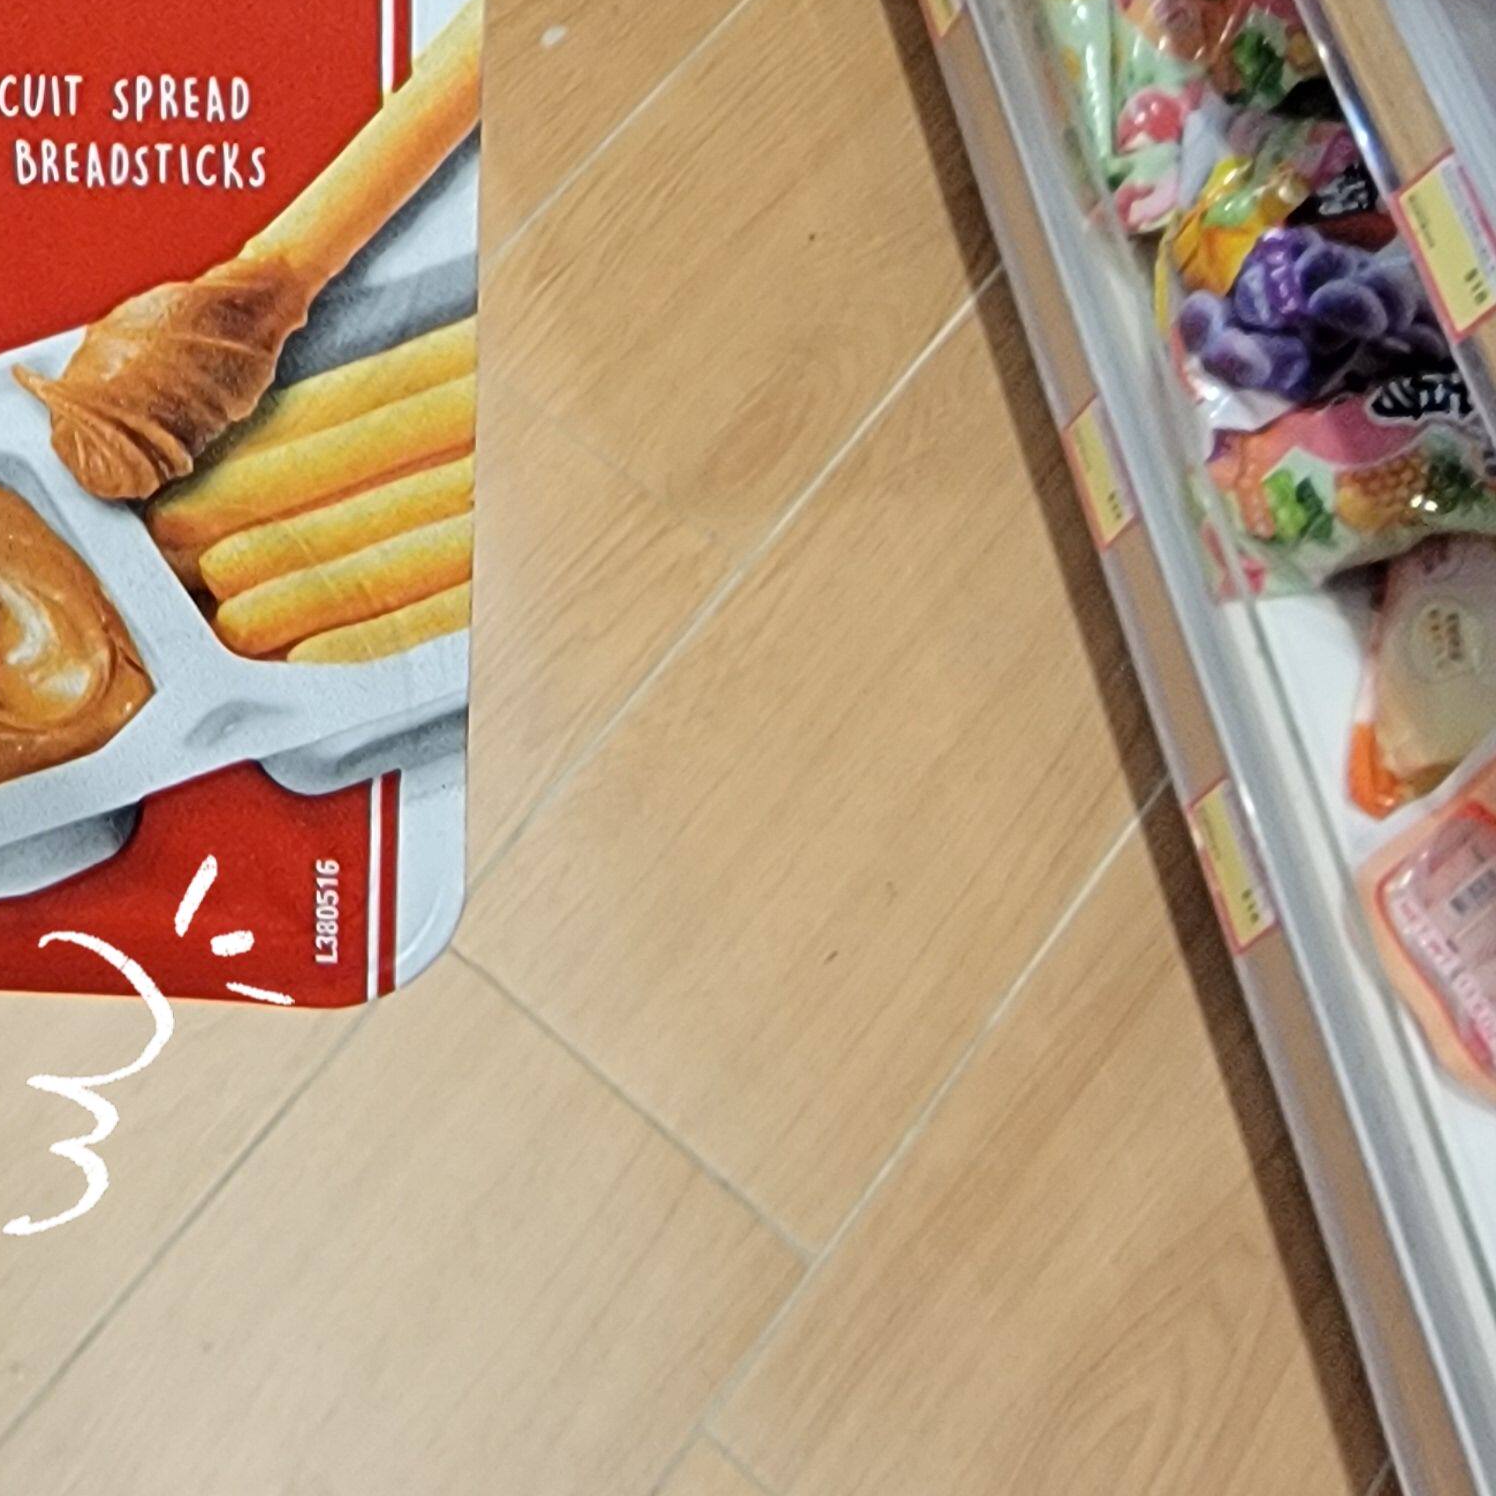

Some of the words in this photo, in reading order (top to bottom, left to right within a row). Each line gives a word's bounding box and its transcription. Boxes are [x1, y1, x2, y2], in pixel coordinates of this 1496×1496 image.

[111, 75, 250, 123] SPREAD
[14, 141, 267, 189] BREADSTICKS
[315, 858, 340, 964] L380516
